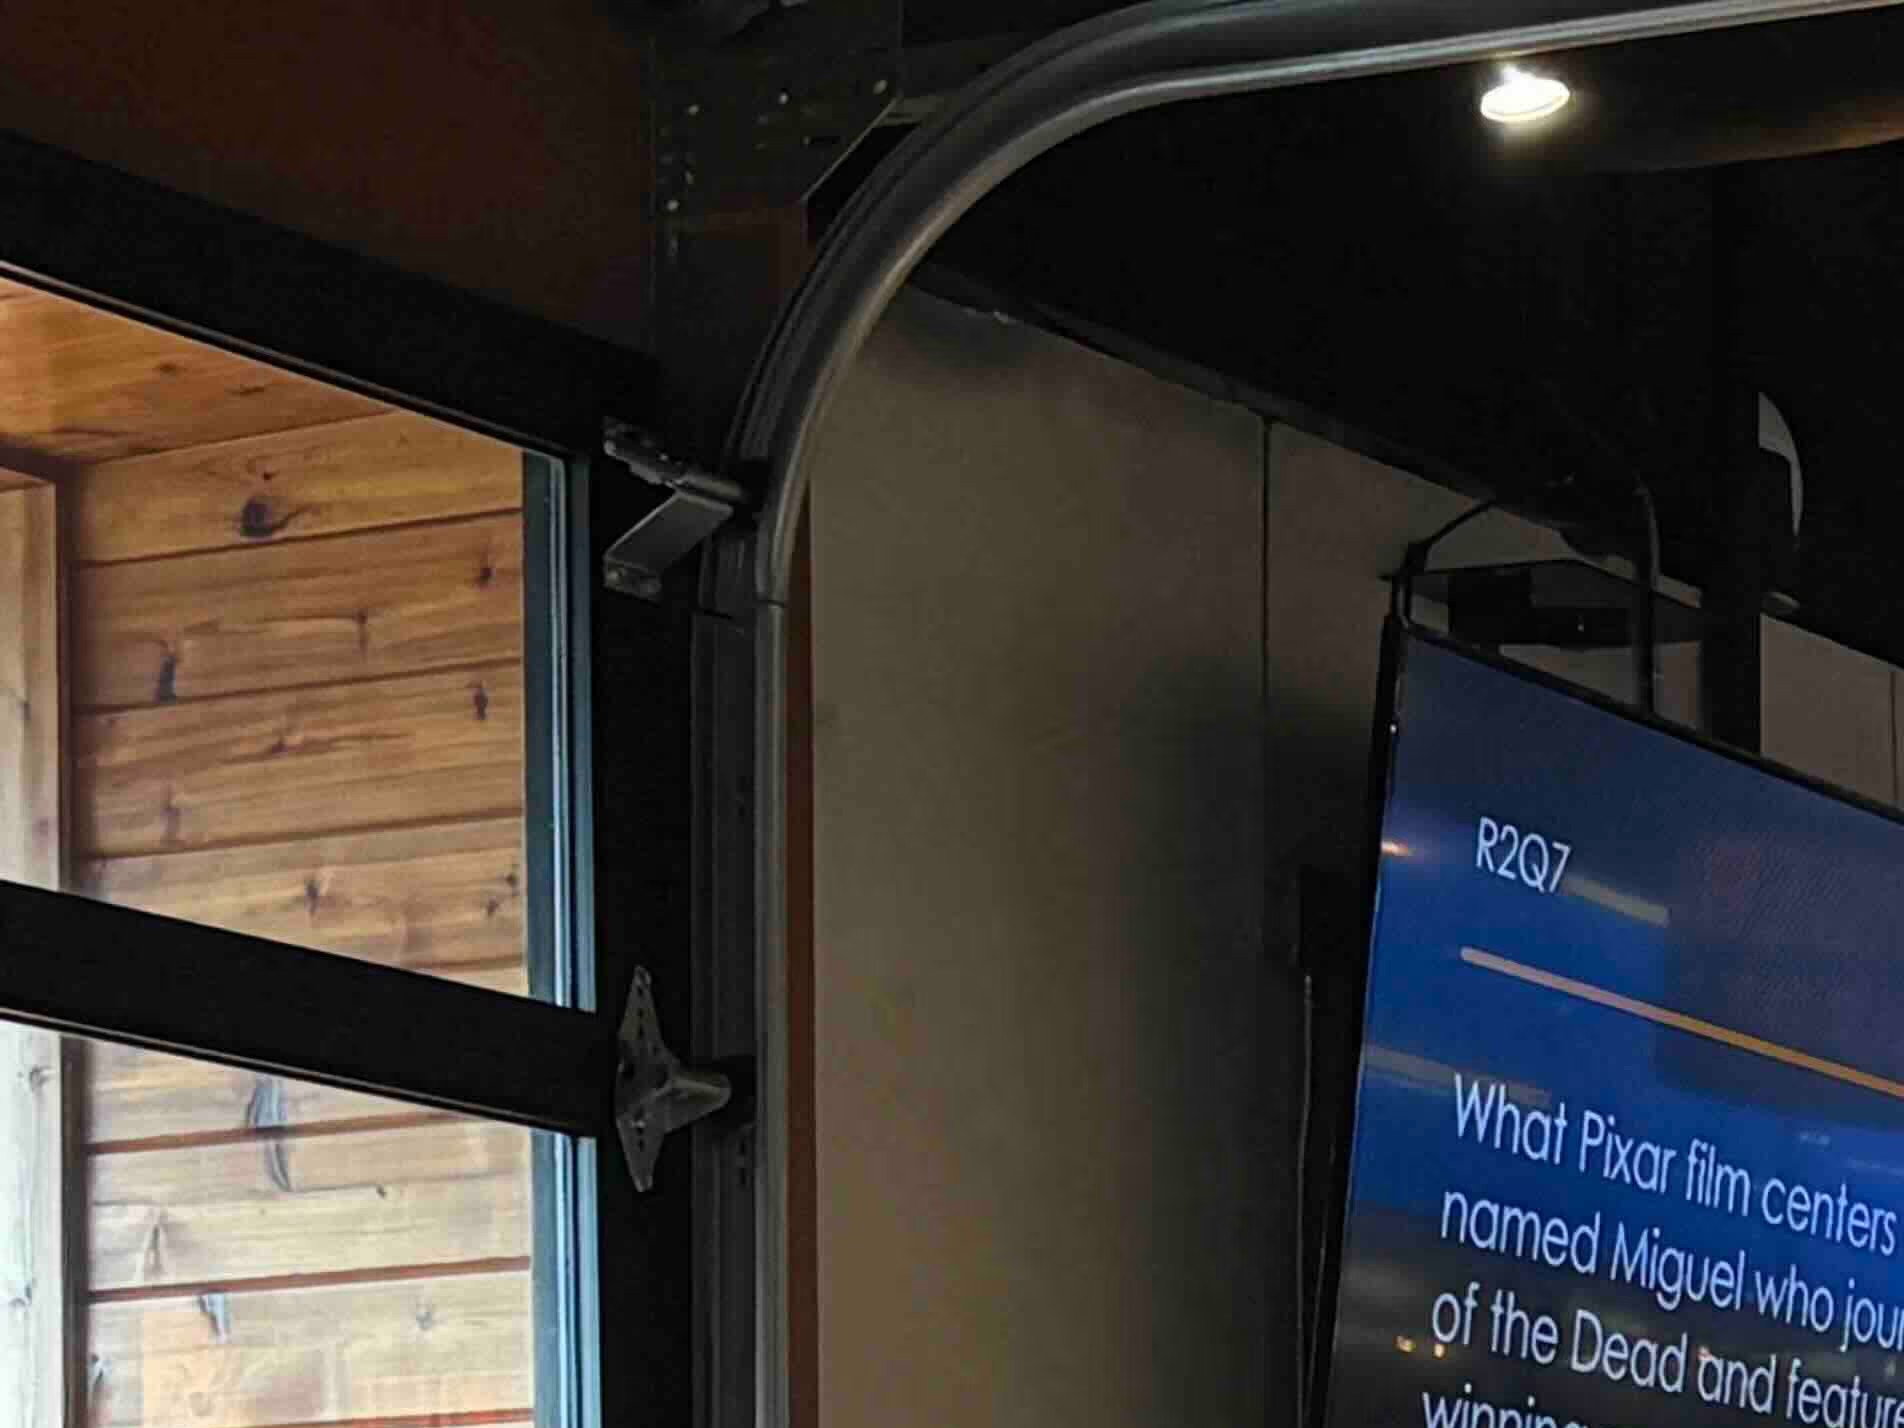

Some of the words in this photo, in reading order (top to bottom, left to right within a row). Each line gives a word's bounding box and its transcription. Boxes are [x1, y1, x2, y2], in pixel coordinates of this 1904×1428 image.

[1476, 816, 1571, 893] R2Q7
[1455, 1072, 1567, 1164] What
[1579, 1110, 1676, 1193] Pixar
[1686, 1139, 1749, 1216] film
[1762, 1177, 1897, 1256] centers
[1441, 1190, 1600, 1274] named
[1610, 1222, 1745, 1311] Miguel
[1754, 1264, 1834, 1332] who
[1432, 1282, 1480, 1345] of
[1490, 1288, 1558, 1364] the
[1570, 1308, 1688, 1393] Dead
[1698, 1352, 1777, 1415] and
